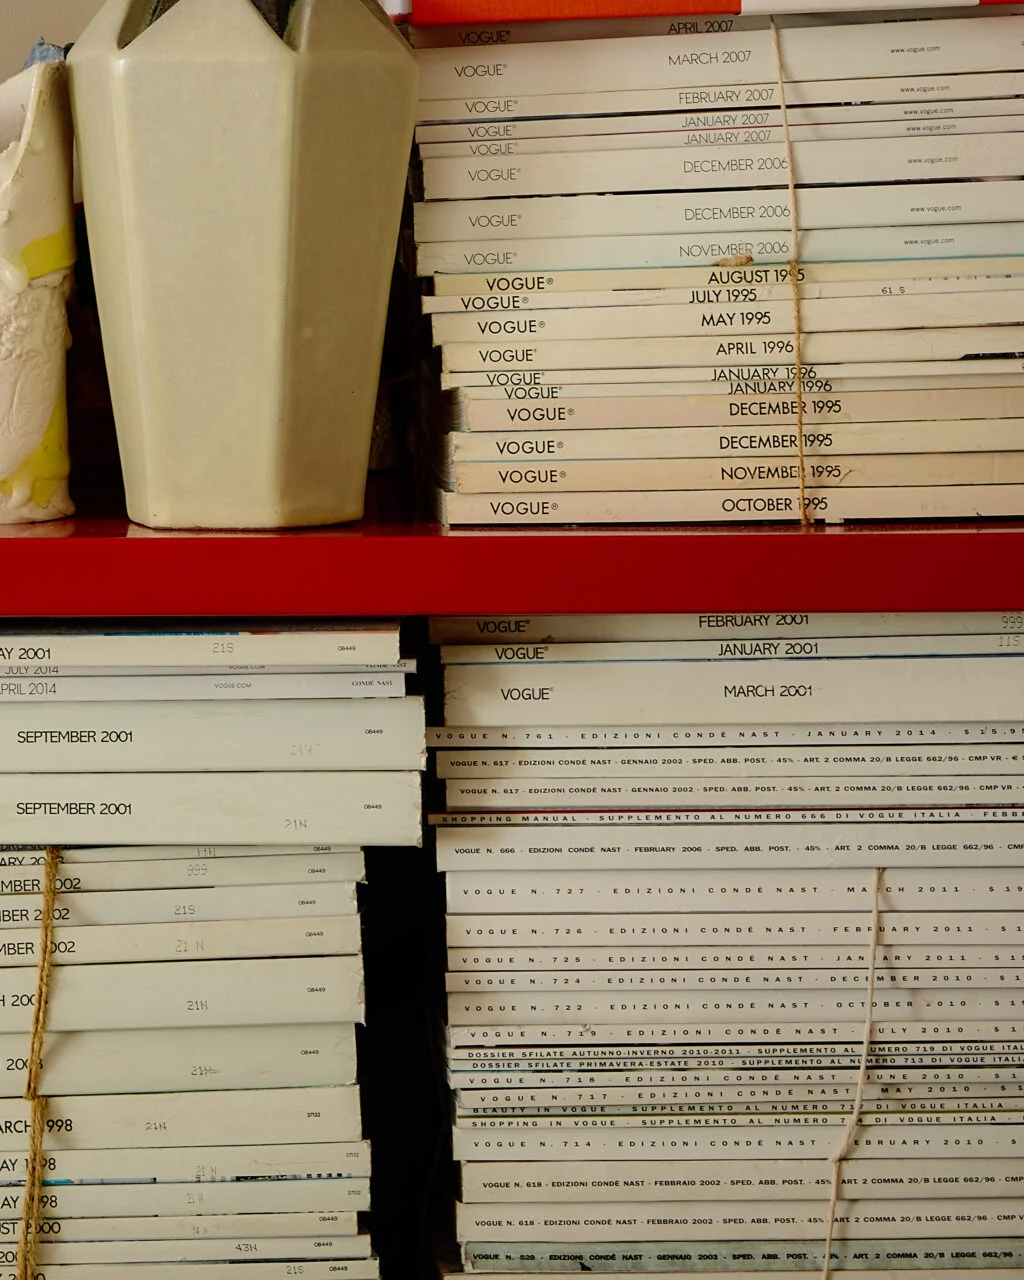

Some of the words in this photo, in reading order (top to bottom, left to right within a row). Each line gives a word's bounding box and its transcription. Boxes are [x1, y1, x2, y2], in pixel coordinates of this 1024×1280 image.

[668, 23, 702, 34] APRIL
[706, 20, 733, 32] 2007
[668, 53, 718, 66] MARCH
[722, 51, 752, 63] 2007
[679, 90, 741, 104] FEBRUARY
[745, 89, 774, 101] 2007
[682, 115, 738, 128] JANUARY
[741, 113, 769, 125] 2007
[684, 132, 740, 145] JANUARY
[744, 130, 771, 142] 2007
[683, 159, 753, 173] DECEMBER
[758, 158, 788, 170] 2006
[685, 207, 755, 220] DECEMBER
[759, 205, 790, 218] 2006
[910, 205, 961, 213] www.vogue.com
[680, 243, 754, 257] NOVEMBER
[757, 242, 789, 254] 2006
[708, 270, 770, 284] AUGUST
[689, 290, 721, 303] JULY
[726, 289, 757, 301] 1995
[702, 313, 736, 326] MAY
[740, 312, 771, 324] 1995
[716, 342, 756, 355] APRIL
[762, 340, 794, 354] 1996
[712, 368, 779, 381] JANUARY
[728, 381, 795, 395] JANUARY
[802, 380, 832, 392] 1996
[730, 401, 807, 416] DECEMBER
[812, 400, 841, 413] 1995
[720, 435, 798, 449] DECEMBER
[803, 434, 833, 447] 1995
[811, 466, 840, 478] 1995
[722, 498, 792, 512] OCTOBER
[699, 614, 770, 628] FEBRUARY
[18, 648, 51, 659] 2001
[718, 642, 780, 656] JANUARY
[785, 642, 819, 655] 2001
[29, 683, 56, 695] 2014
[724, 685, 775, 698] MARCH
[780, 685, 812, 697] 2001
[17, 731, 96, 743] SEPTEMBER
[101, 731, 133, 743] 2001
[17, 803, 95, 815] SEPTEMBER
[100, 803, 132, 815] 2001
